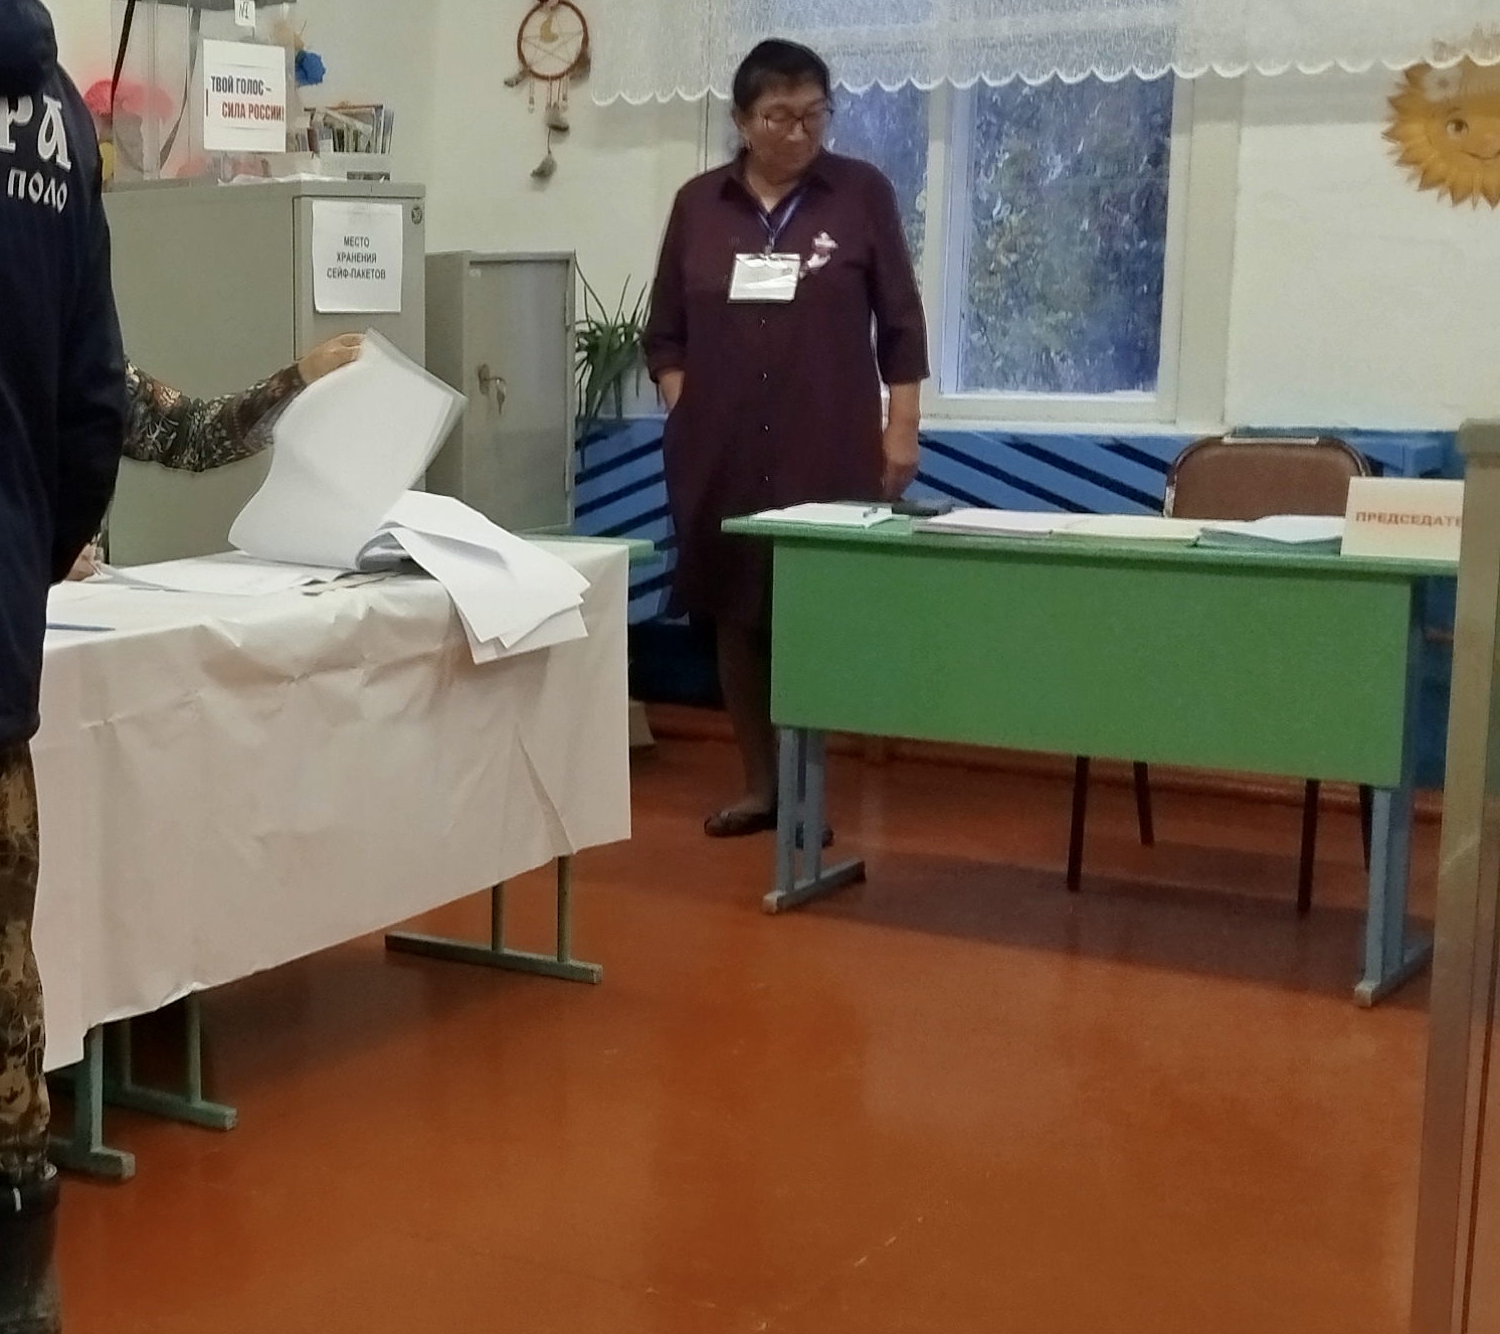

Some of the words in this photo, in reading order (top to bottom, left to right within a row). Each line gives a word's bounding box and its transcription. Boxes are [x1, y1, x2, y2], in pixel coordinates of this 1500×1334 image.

[211, 75, 234, 94] ТВОЙ
[236, 78, 264, 96] ГОЛОС
[221, 101, 246, 120] СИЛА
[248, 103, 285, 122] РОССИИ!
[7, 168, 68, 213] ПОЛО
[343, 235, 370, 248] МЕСТО
[336, 251, 377, 264] ХРАНЕНИЯ
[326, 267, 386, 280] СЕЙФ-ПАКЕТОВ
